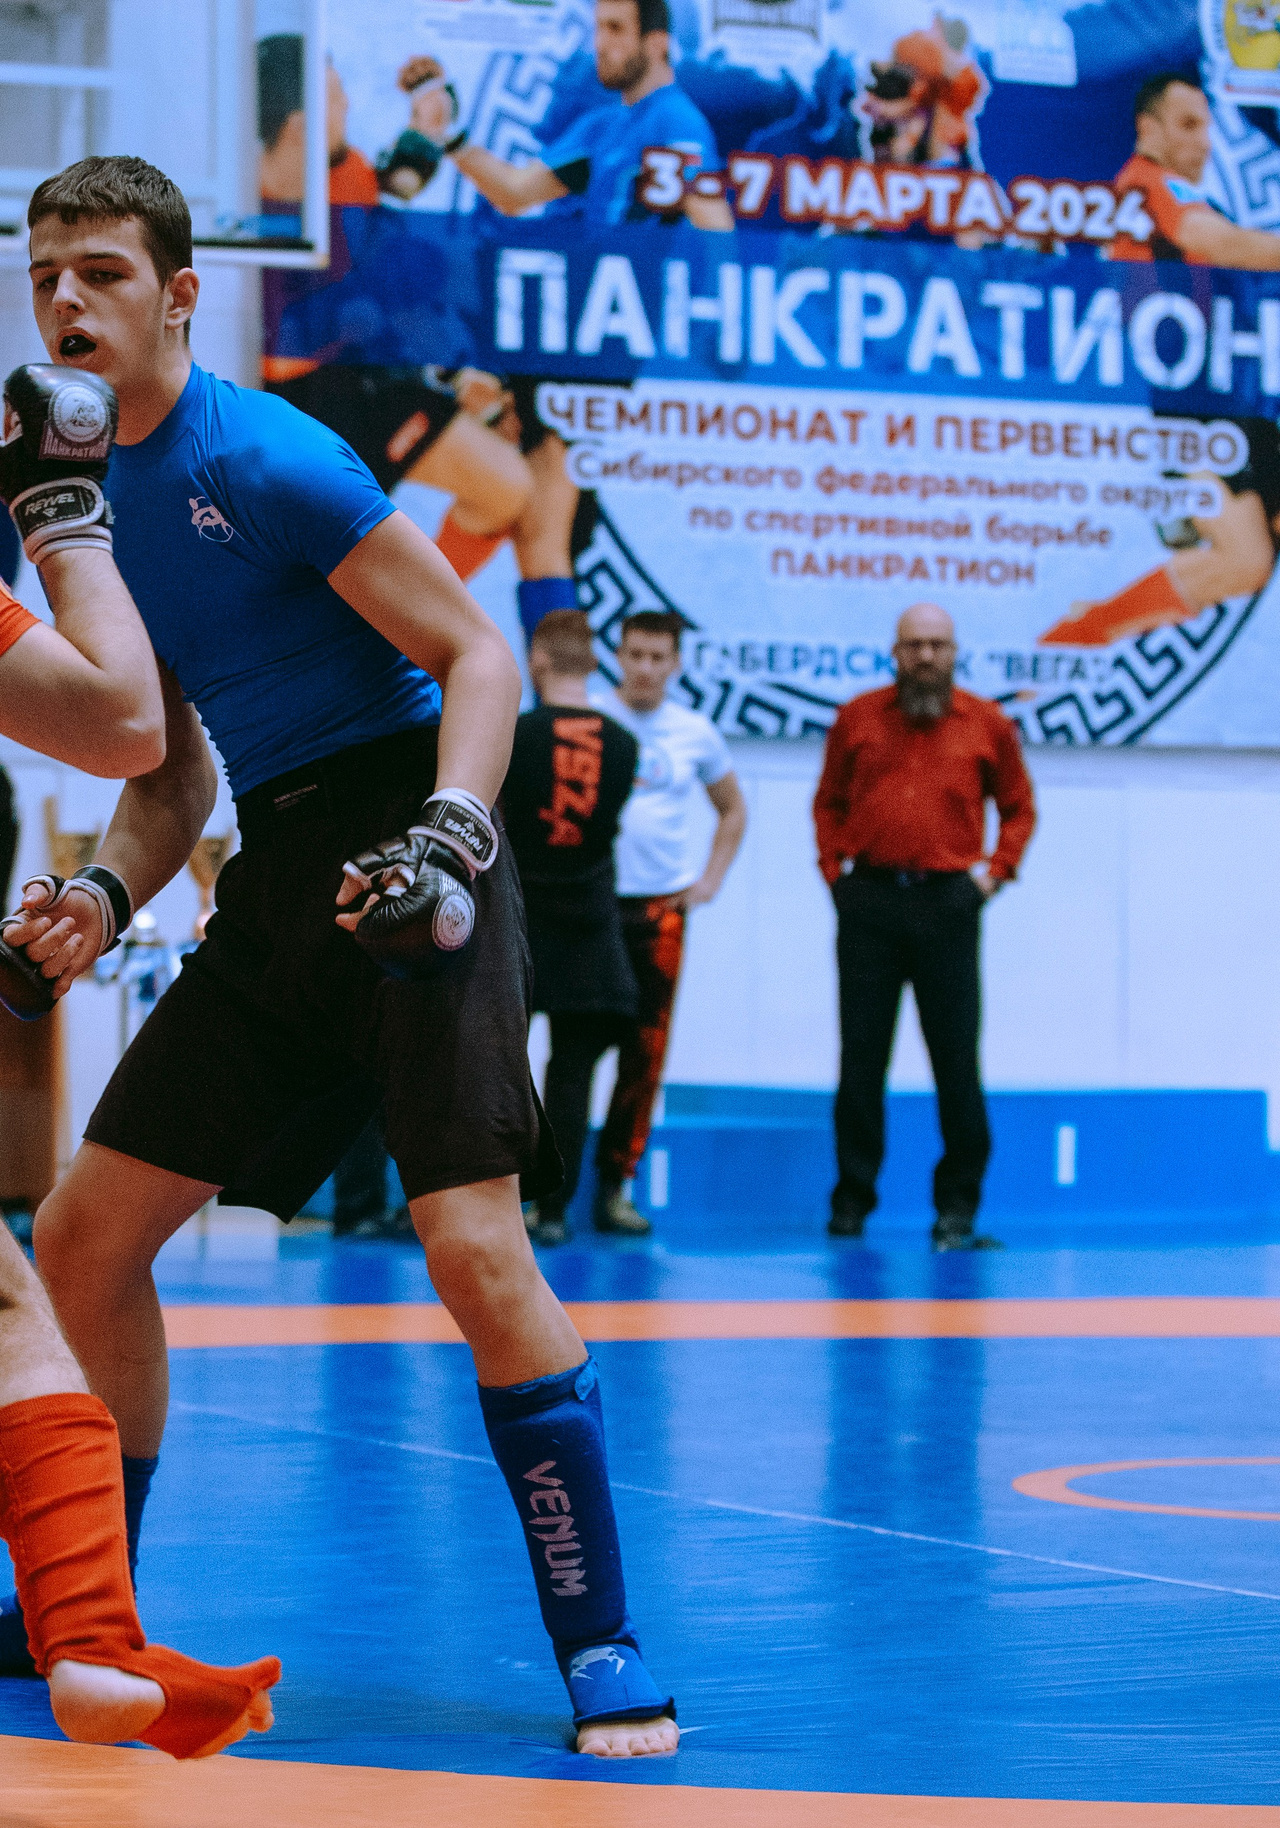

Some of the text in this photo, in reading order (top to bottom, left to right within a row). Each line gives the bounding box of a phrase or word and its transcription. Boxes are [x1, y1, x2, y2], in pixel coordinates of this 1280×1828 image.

[642, 152, 681, 207] 3
[729, 159, 773, 211] 7
[789, 162, 1001, 230] МАРТА
[1014, 180, 1155, 242] 2024
[494, 247, 1280, 393] ПАНКРАТИОН
[547, 395, 1238, 466] ЧЕМПИОНАТ И ПЕРВЕНСТВО
[574, 450, 1216, 515] Сибирского федерального округа
[689, 504, 1111, 548] по спортивной борьбе
[770, 549, 1037, 587] ПАНКРАТИОН
[523, 1459, 588, 1597] VENUM
